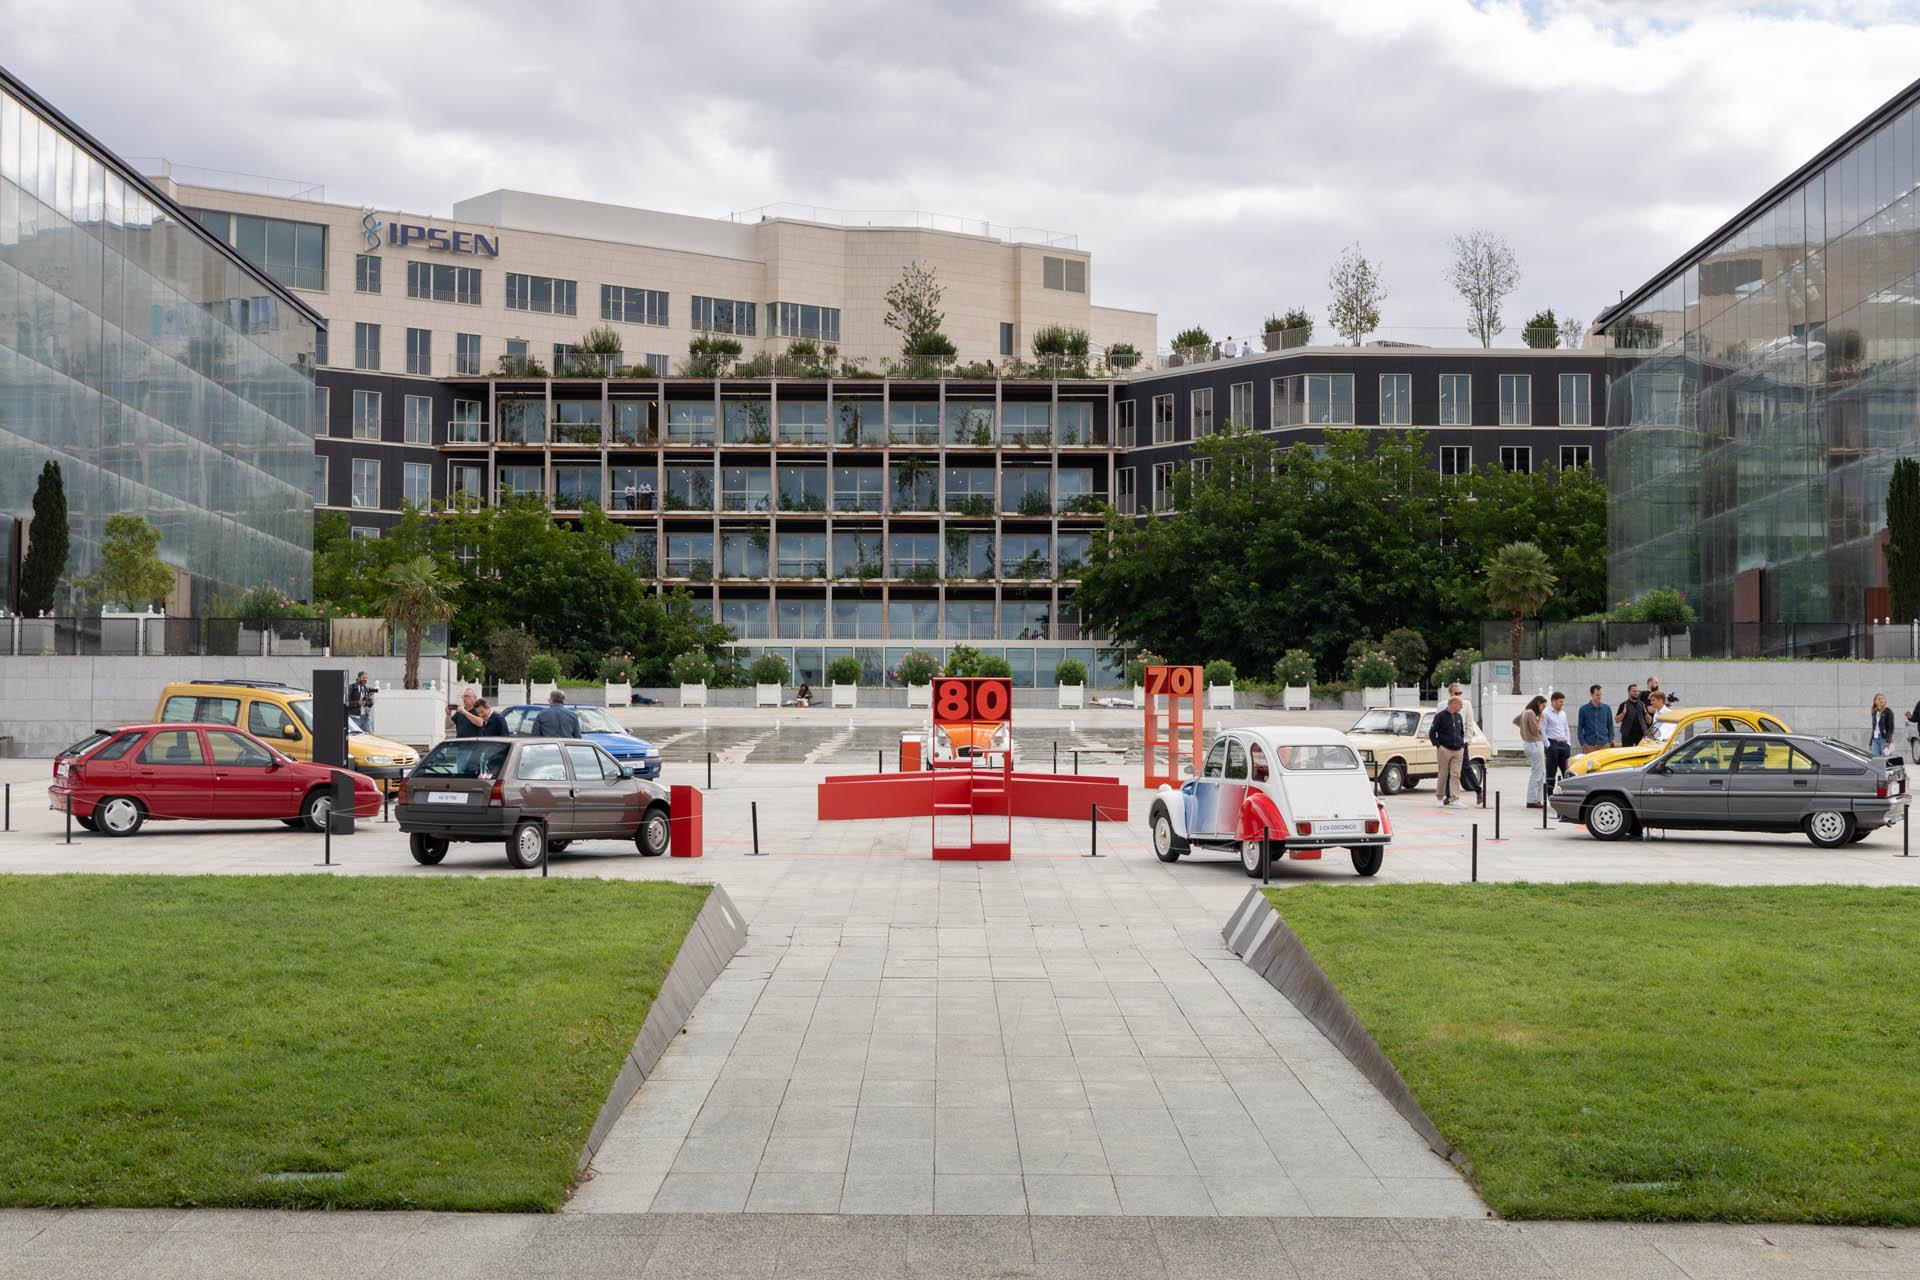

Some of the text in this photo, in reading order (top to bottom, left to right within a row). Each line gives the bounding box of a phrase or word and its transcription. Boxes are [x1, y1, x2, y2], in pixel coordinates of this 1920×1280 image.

[389, 222, 499, 257] IPSEN
[1148, 666, 1192, 694] 70
[937, 680, 1008, 720] 80
